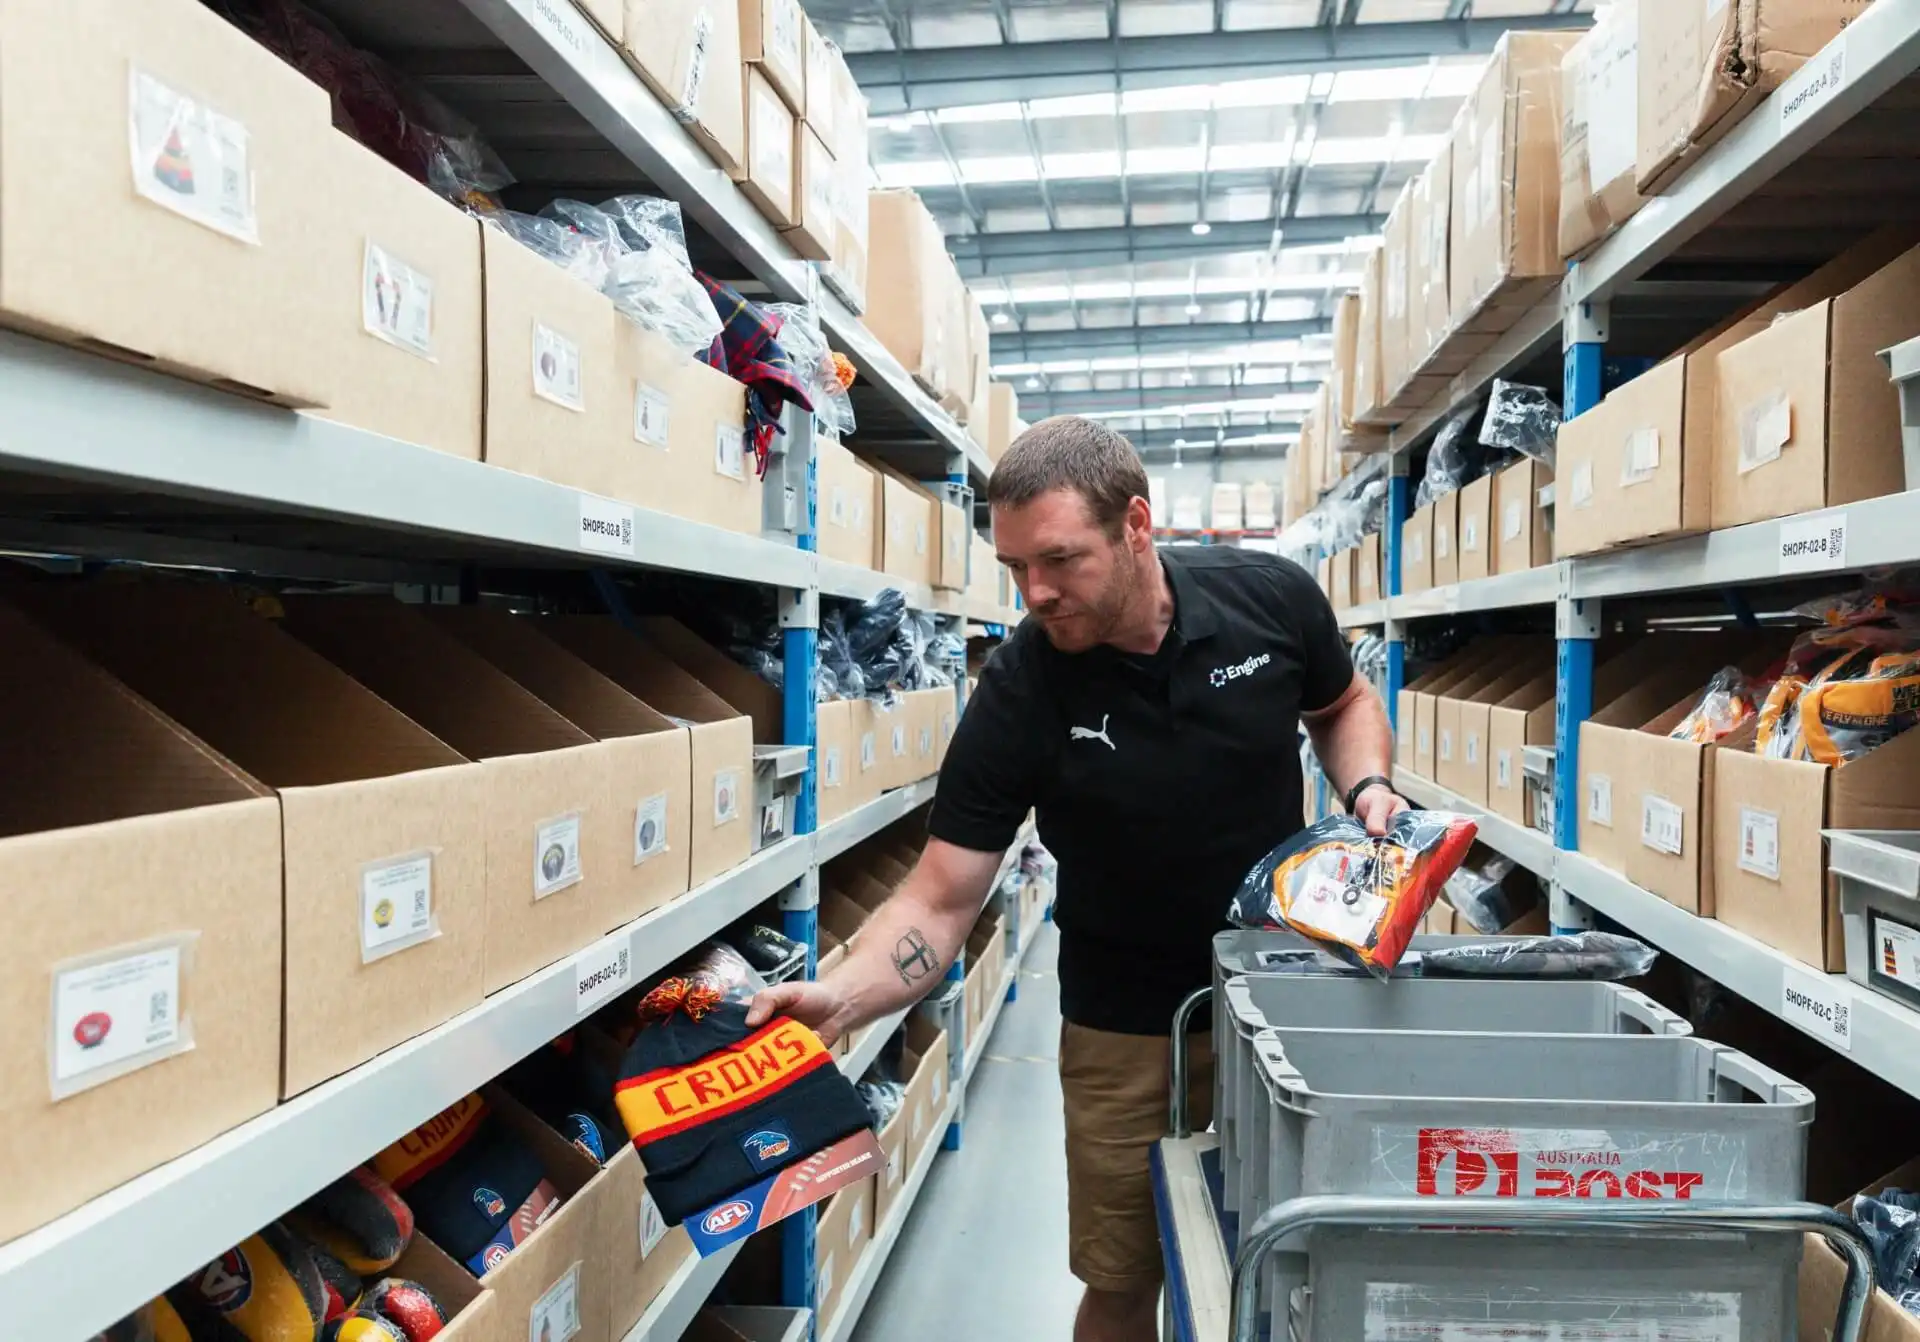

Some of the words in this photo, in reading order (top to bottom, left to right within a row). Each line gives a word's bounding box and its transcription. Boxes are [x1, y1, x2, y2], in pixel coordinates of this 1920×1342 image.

[1783, 73, 1827, 119] SHOPF-02-A
[582, 517, 620, 537] SHOPE-02-B
[1782, 538, 1827, 557] SHOPF-02-B
[1226, 653, 1271, 680] Engine
[1833, 713, 1852, 726] FLY
[1863, 714, 1889, 727] ONE
[579, 962, 617, 995] SHOPE-02-C
[1786, 988, 1832, 1021] SHOPF-02-C
[654, 1030, 807, 1117] CROWS
[1536, 1150, 1621, 1165] AUSTRALIA
[709, 1205, 750, 1232] AFL
